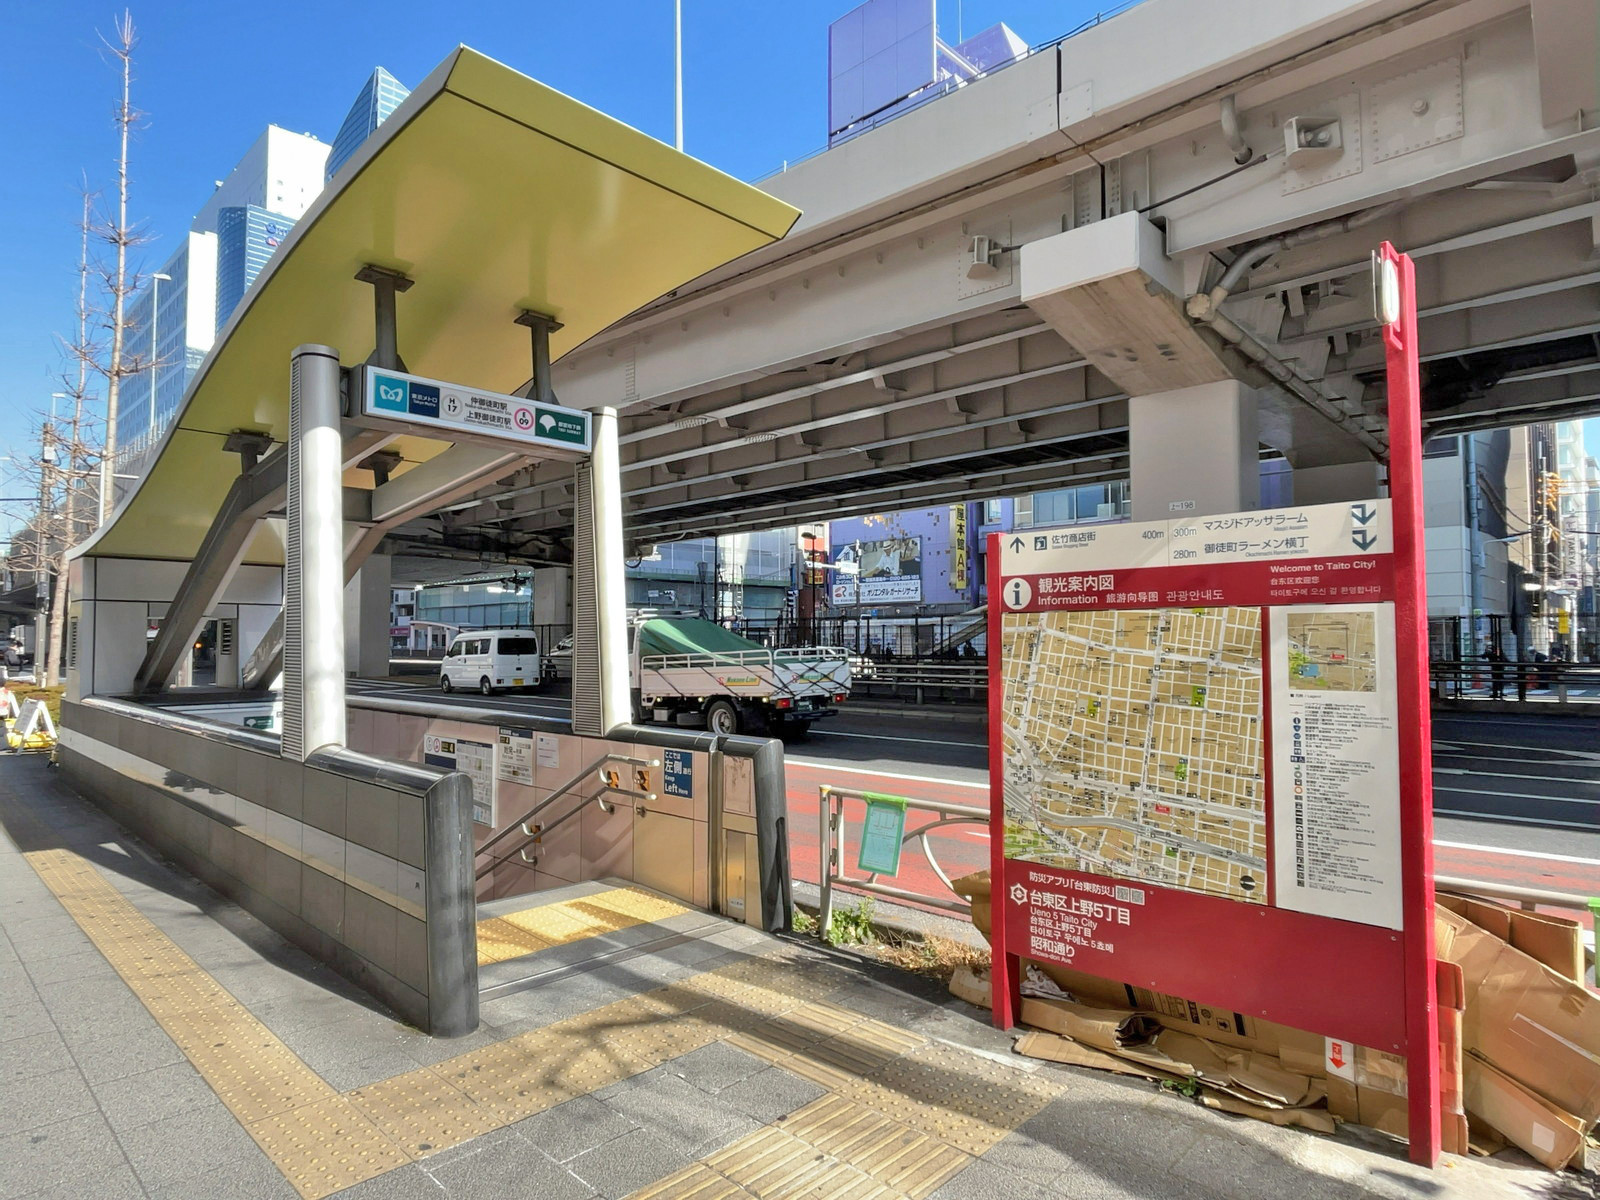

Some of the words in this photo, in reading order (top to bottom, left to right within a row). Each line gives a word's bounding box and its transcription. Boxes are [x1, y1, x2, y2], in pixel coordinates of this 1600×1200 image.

[411, 393, 438, 403] 東京メトロ
[448, 397, 455, 405] H
[470, 396, 508, 411] 仲御徒町駅
[447, 404, 457, 413] 17
[466, 410, 512, 426] 上野御徒町駅
[519, 418, 529, 426] 09
[1203, 512, 1309, 531] マスジドアッサラーム
[1051, 531, 1097, 545] 佐竹商店街
[1142, 530, 1165, 540] 400m
[1173, 527, 1197, 538] 300m
[956, 503, 966, 582] 屋本館A棟
[1204, 535, 1309, 554] 御徒町ラーメン横丁
[1173, 549, 1197, 560] 280m
[1270, 565, 1312, 573] Welcome
[1314, 563, 1324, 571] to
[1326, 562, 1351, 570] Taito
[1353, 560, 1376, 569] City!
[1038, 574, 1114, 594] 観光案内図
[1037, 594, 1098, 605] Information
[1106, 591, 1159, 603] 旅游向导图
[1166, 589, 1225, 602] 관광안내도
[664, 751, 681, 760] ここでは
[664, 782, 678, 794] Left
[1029, 871, 1115, 898] 防災アプリ「台東防災」
[1030, 889, 1131, 927] 台東区上野5丁目
[1030, 906, 1051, 919] Ueno
[1052, 911, 1059, 920] 5
[1060, 912, 1079, 925] Taito
[1081, 917, 1098, 931] City
[1030, 916, 1092, 938] 台东区上野5丁目
[1030, 925, 1062, 940] 타이토구
[1064, 932, 1090, 948] 우에노
[1030, 936, 1075, 958] 昭和通り
